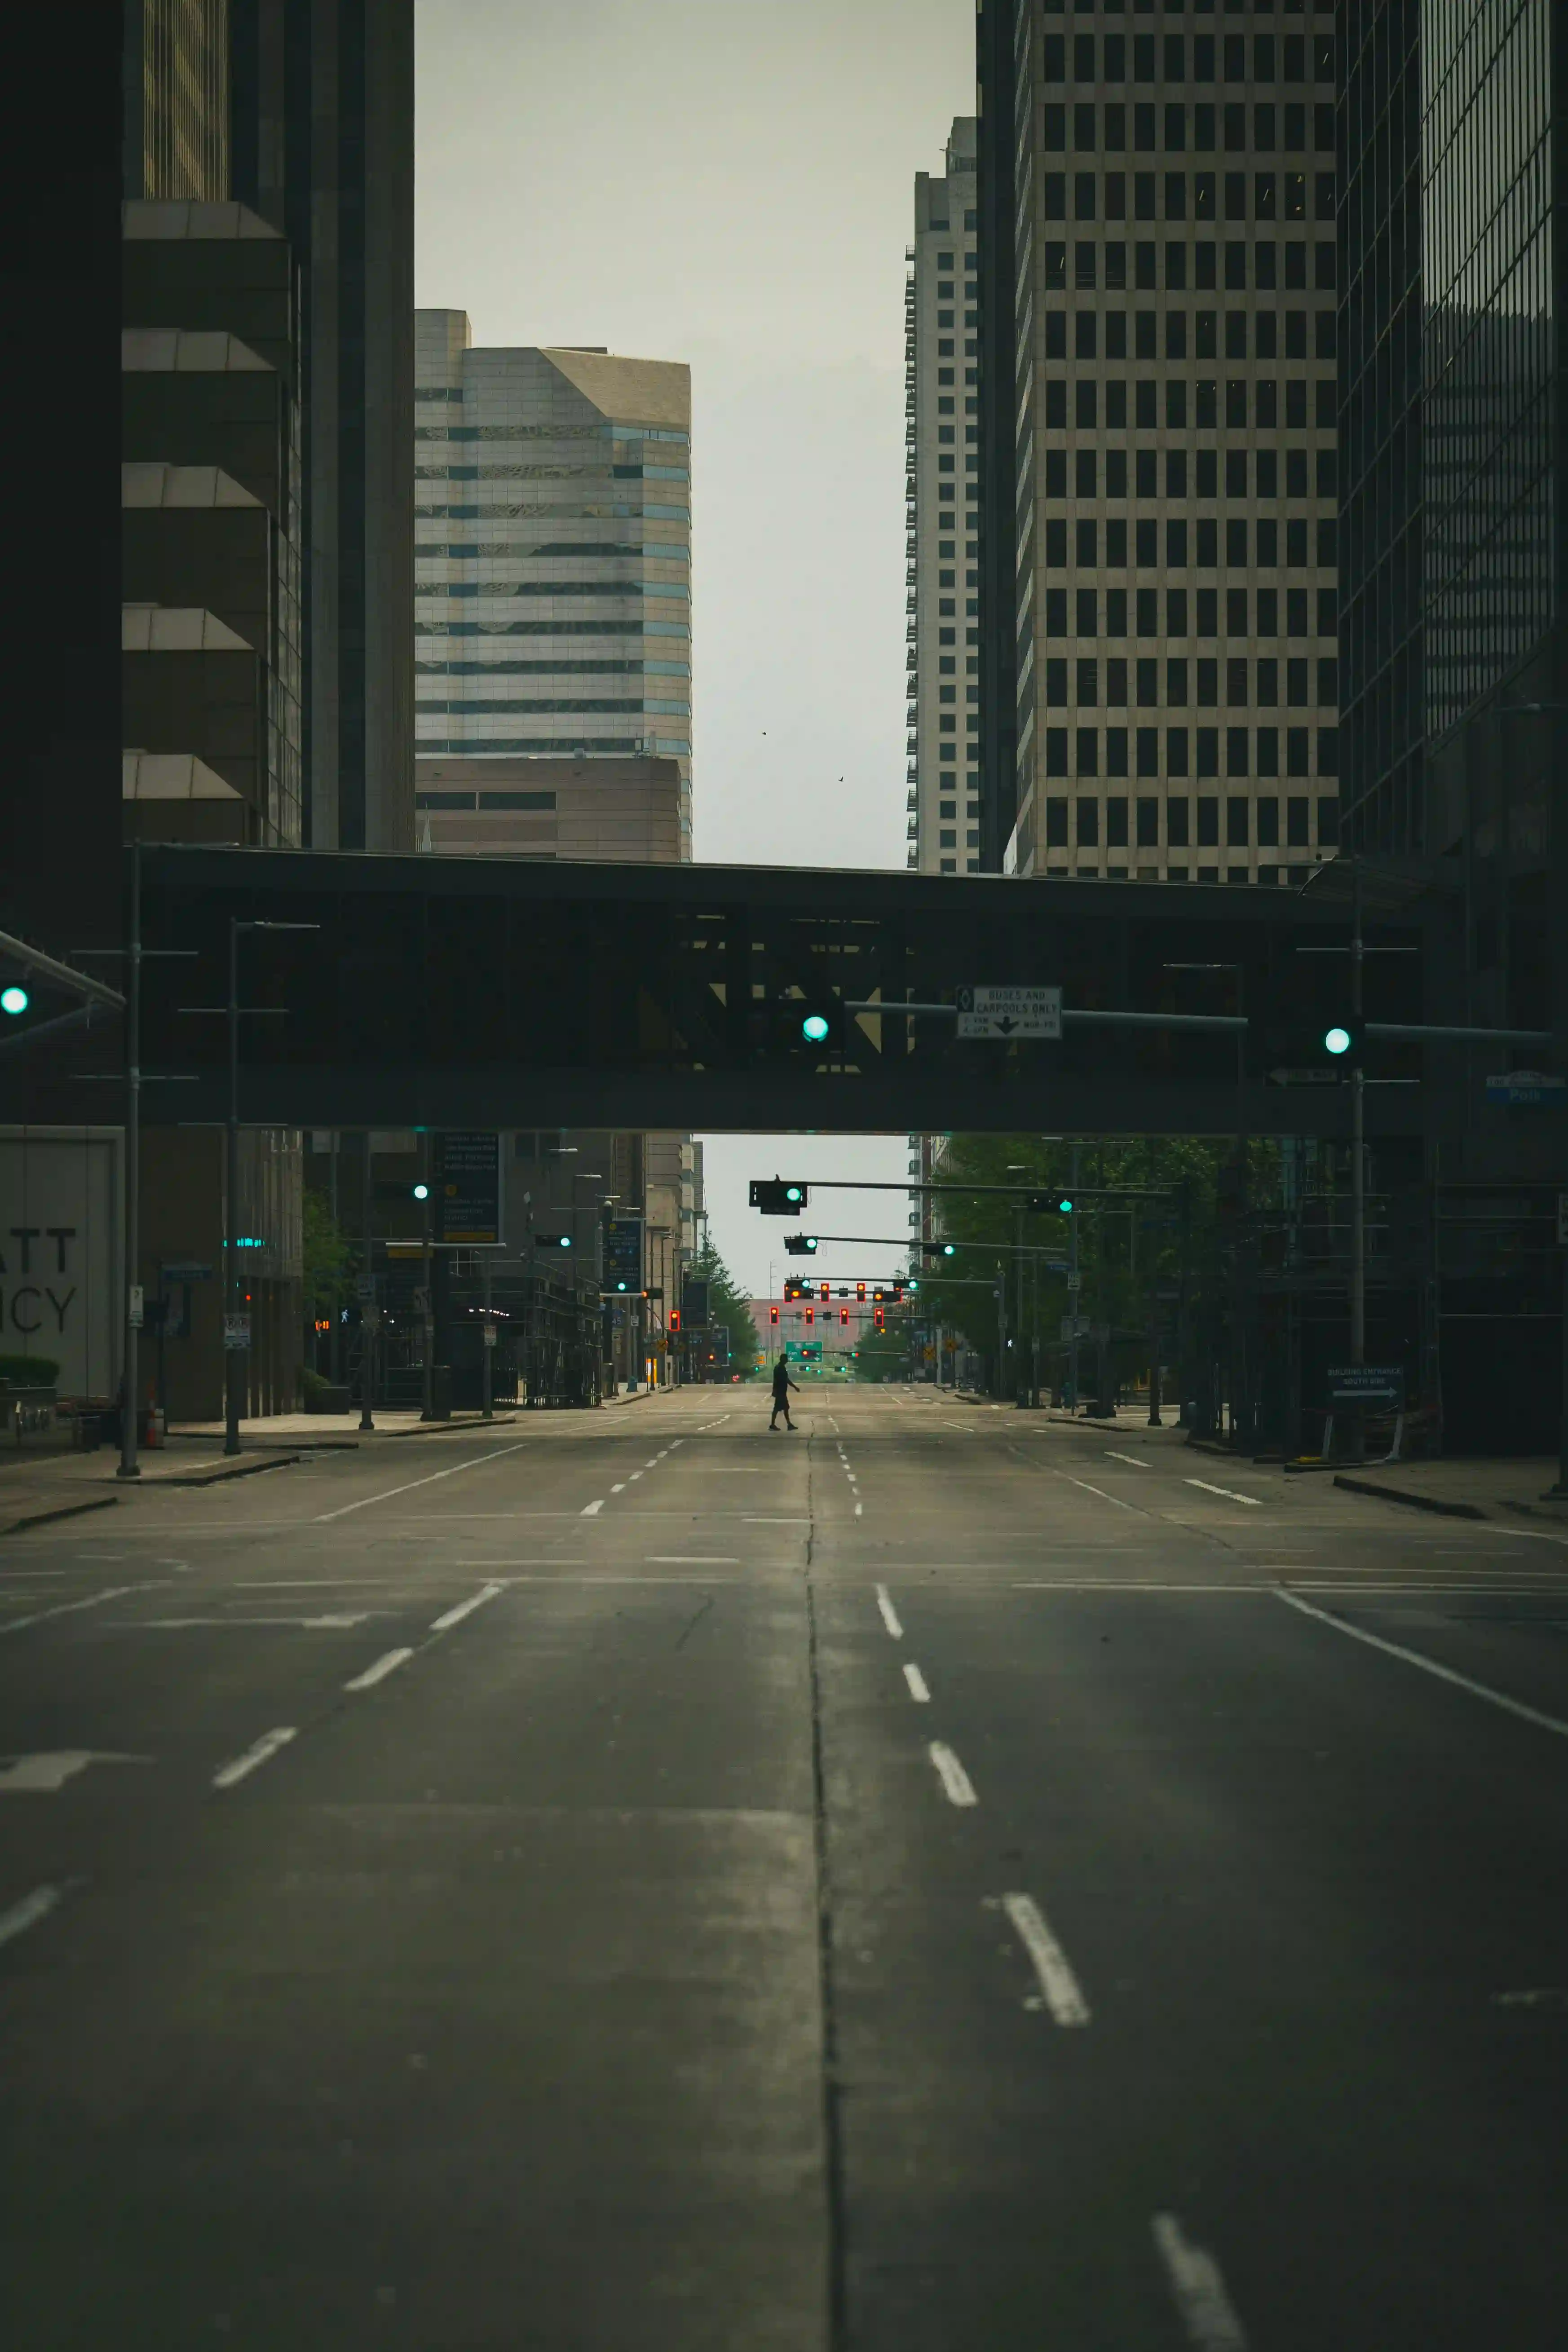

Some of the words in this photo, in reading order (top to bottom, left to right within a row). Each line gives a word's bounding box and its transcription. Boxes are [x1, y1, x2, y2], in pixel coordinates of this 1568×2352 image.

[989, 990, 1021, 1001] BUSES
[1025, 990, 1045, 1001] AND
[976, 1002, 1028, 1014] CARPOOLS
[1032, 1003, 1057, 1014] ONLY
[1509, 1088, 1541, 1101] Polk
[0, 1227, 75, 1274] TT
[0, 1286, 77, 1334] CY
